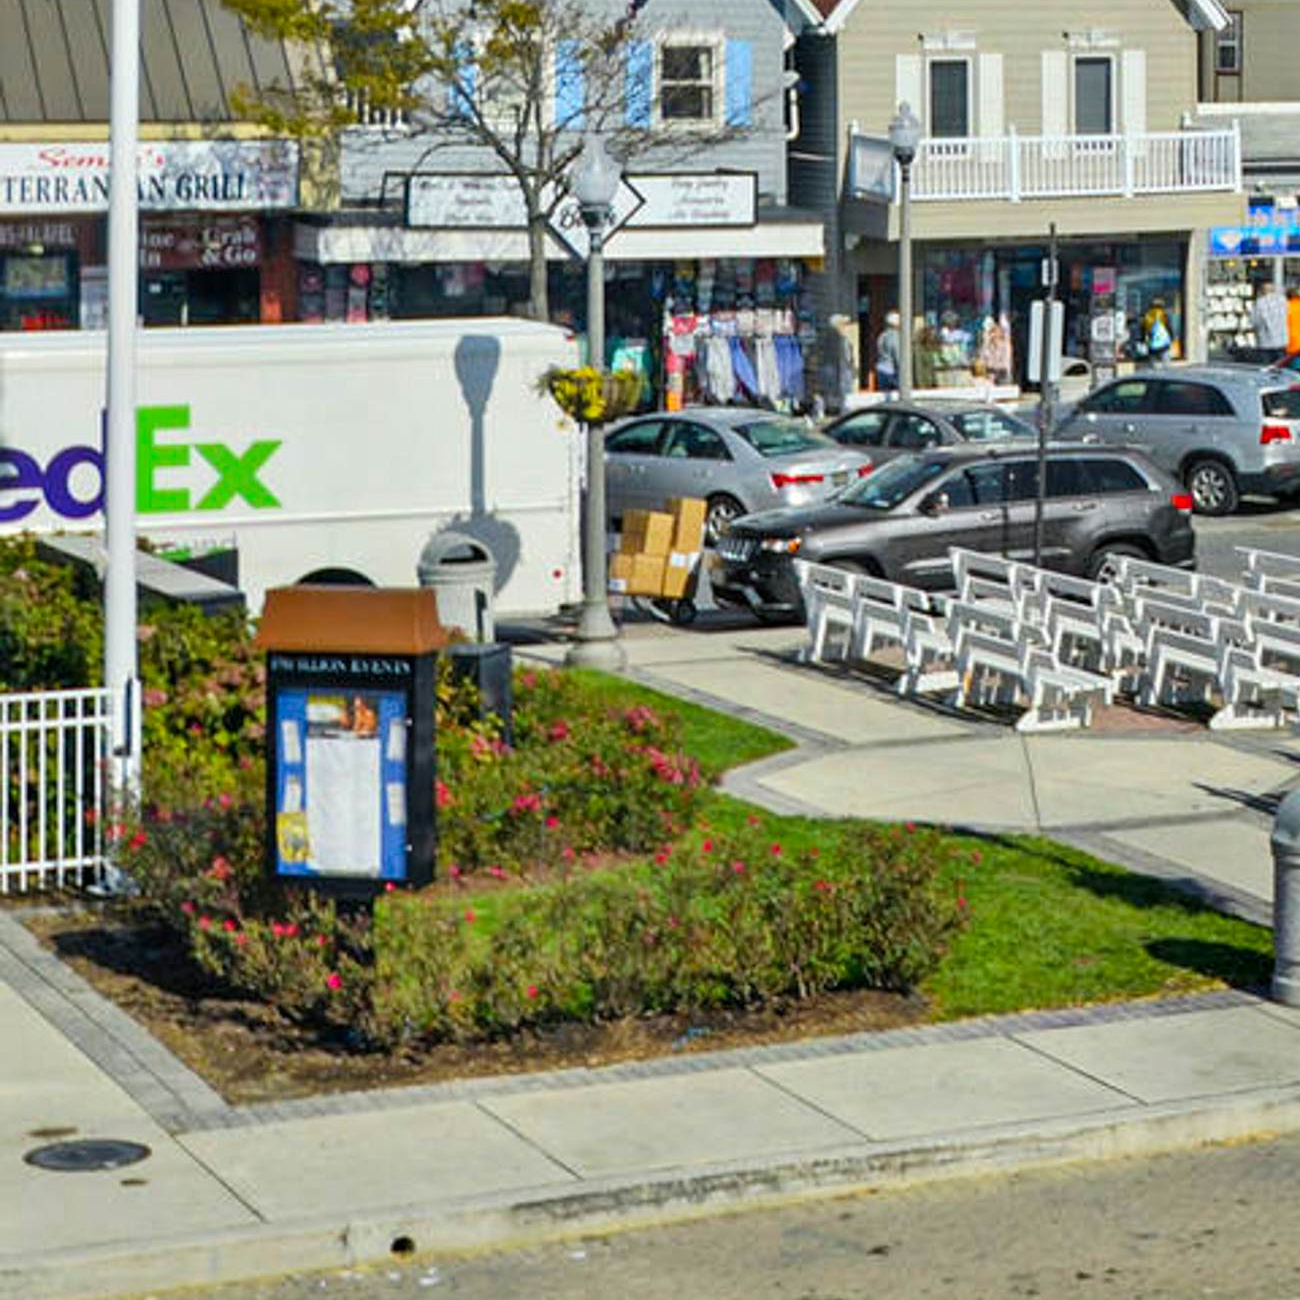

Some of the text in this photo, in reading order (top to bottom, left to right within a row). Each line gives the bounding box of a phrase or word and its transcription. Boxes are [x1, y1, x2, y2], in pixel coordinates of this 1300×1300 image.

[174, 171, 245, 201] GRILL
[224, 246, 257, 264] Go
[351, 659, 411, 675] EVENTS
